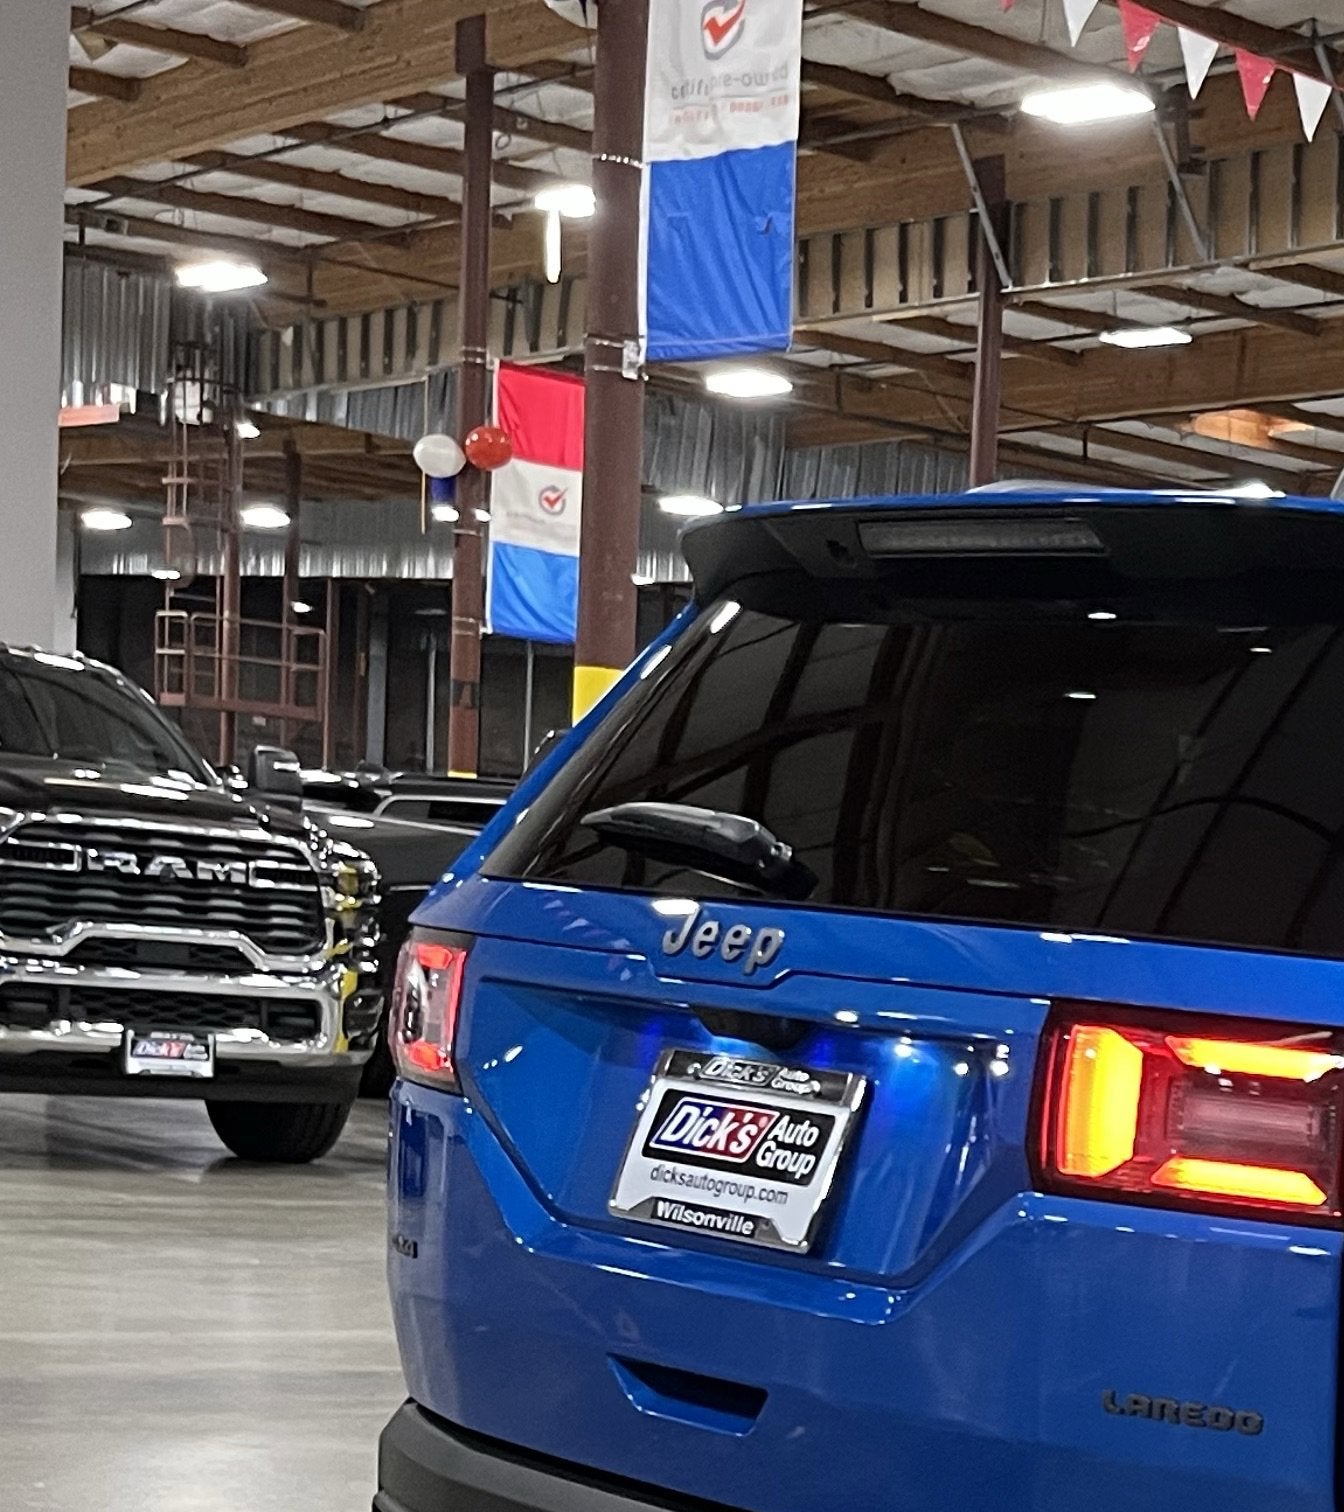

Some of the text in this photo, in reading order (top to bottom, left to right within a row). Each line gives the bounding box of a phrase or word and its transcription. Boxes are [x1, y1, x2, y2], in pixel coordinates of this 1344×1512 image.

[87, 848, 247, 884] RAM
[661, 903, 785, 975] Jeep
[661, 1104, 820, 1154] Dick's Auto
[756, 1140, 817, 1179] Group
[650, 1164, 788, 1205] dicksautogroup.com
[657, 1200, 755, 1235] Wilsonville
[1102, 1388, 1265, 1436] LAREDO
